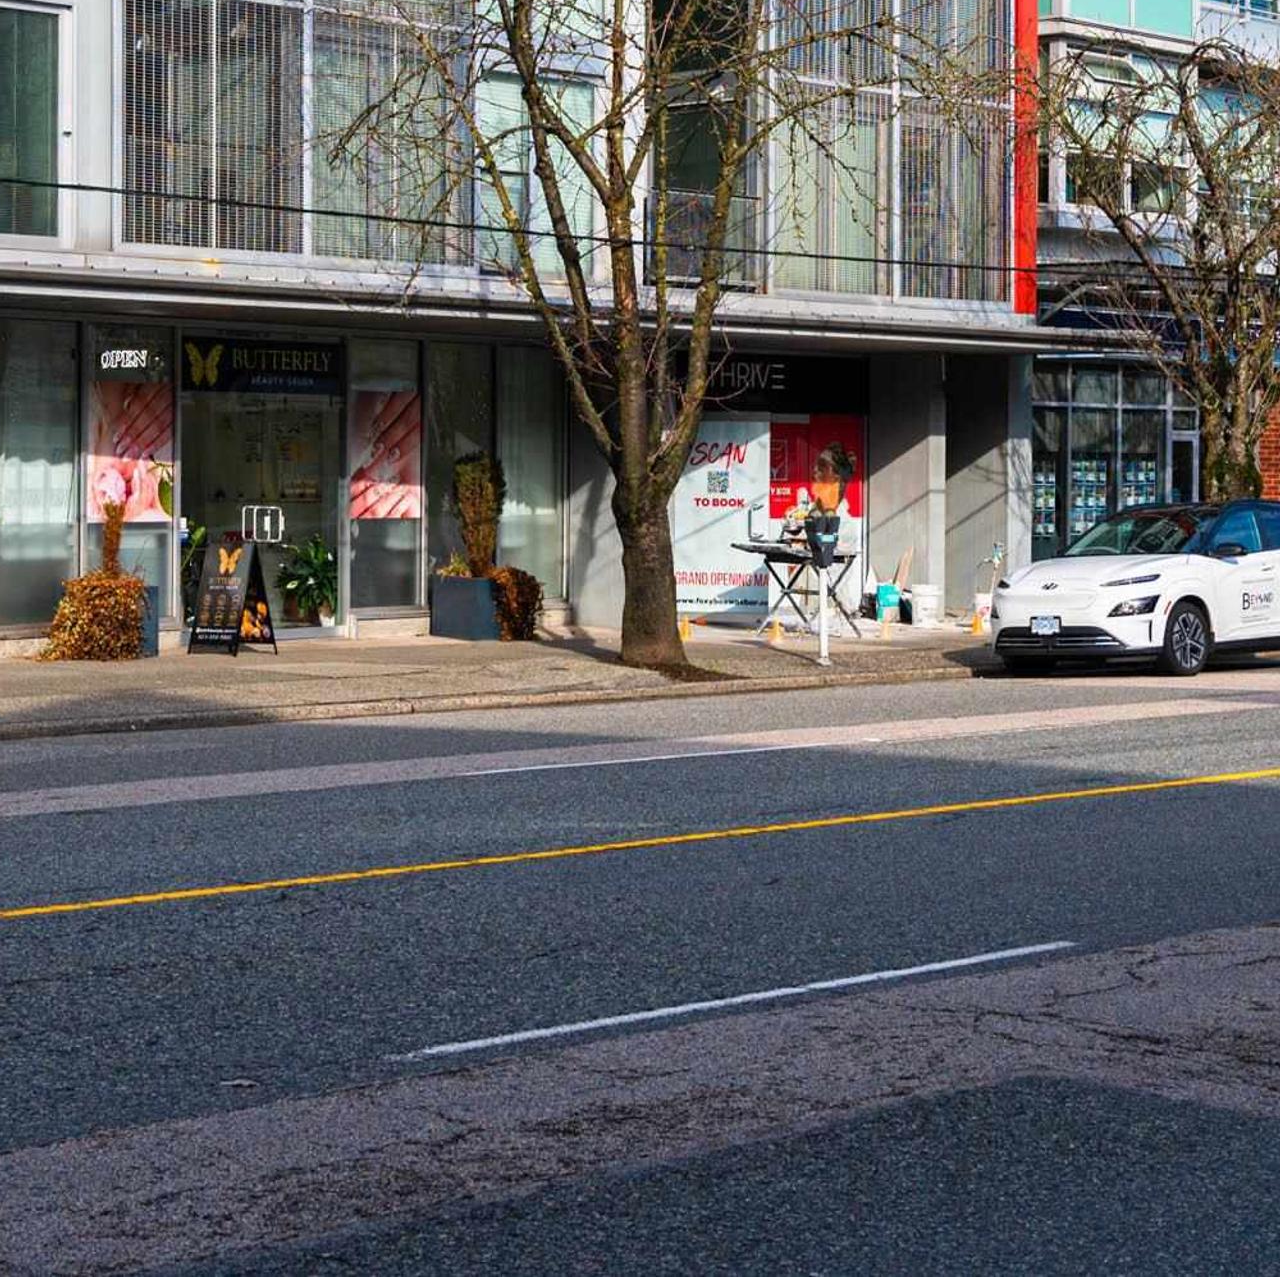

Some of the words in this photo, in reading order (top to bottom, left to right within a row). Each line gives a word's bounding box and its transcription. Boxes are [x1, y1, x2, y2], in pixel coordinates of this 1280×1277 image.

[100, 350, 148, 369] OPEN
[232, 349, 331, 372] BUTTERFLY
[707, 361, 786, 390] THRIVE
[690, 439, 749, 470] SCAN
[694, 497, 710, 507] TO
[712, 498, 745, 507] BOOK
[675, 571, 708, 586] GRAND
[710, 572, 751, 586] OPENING
